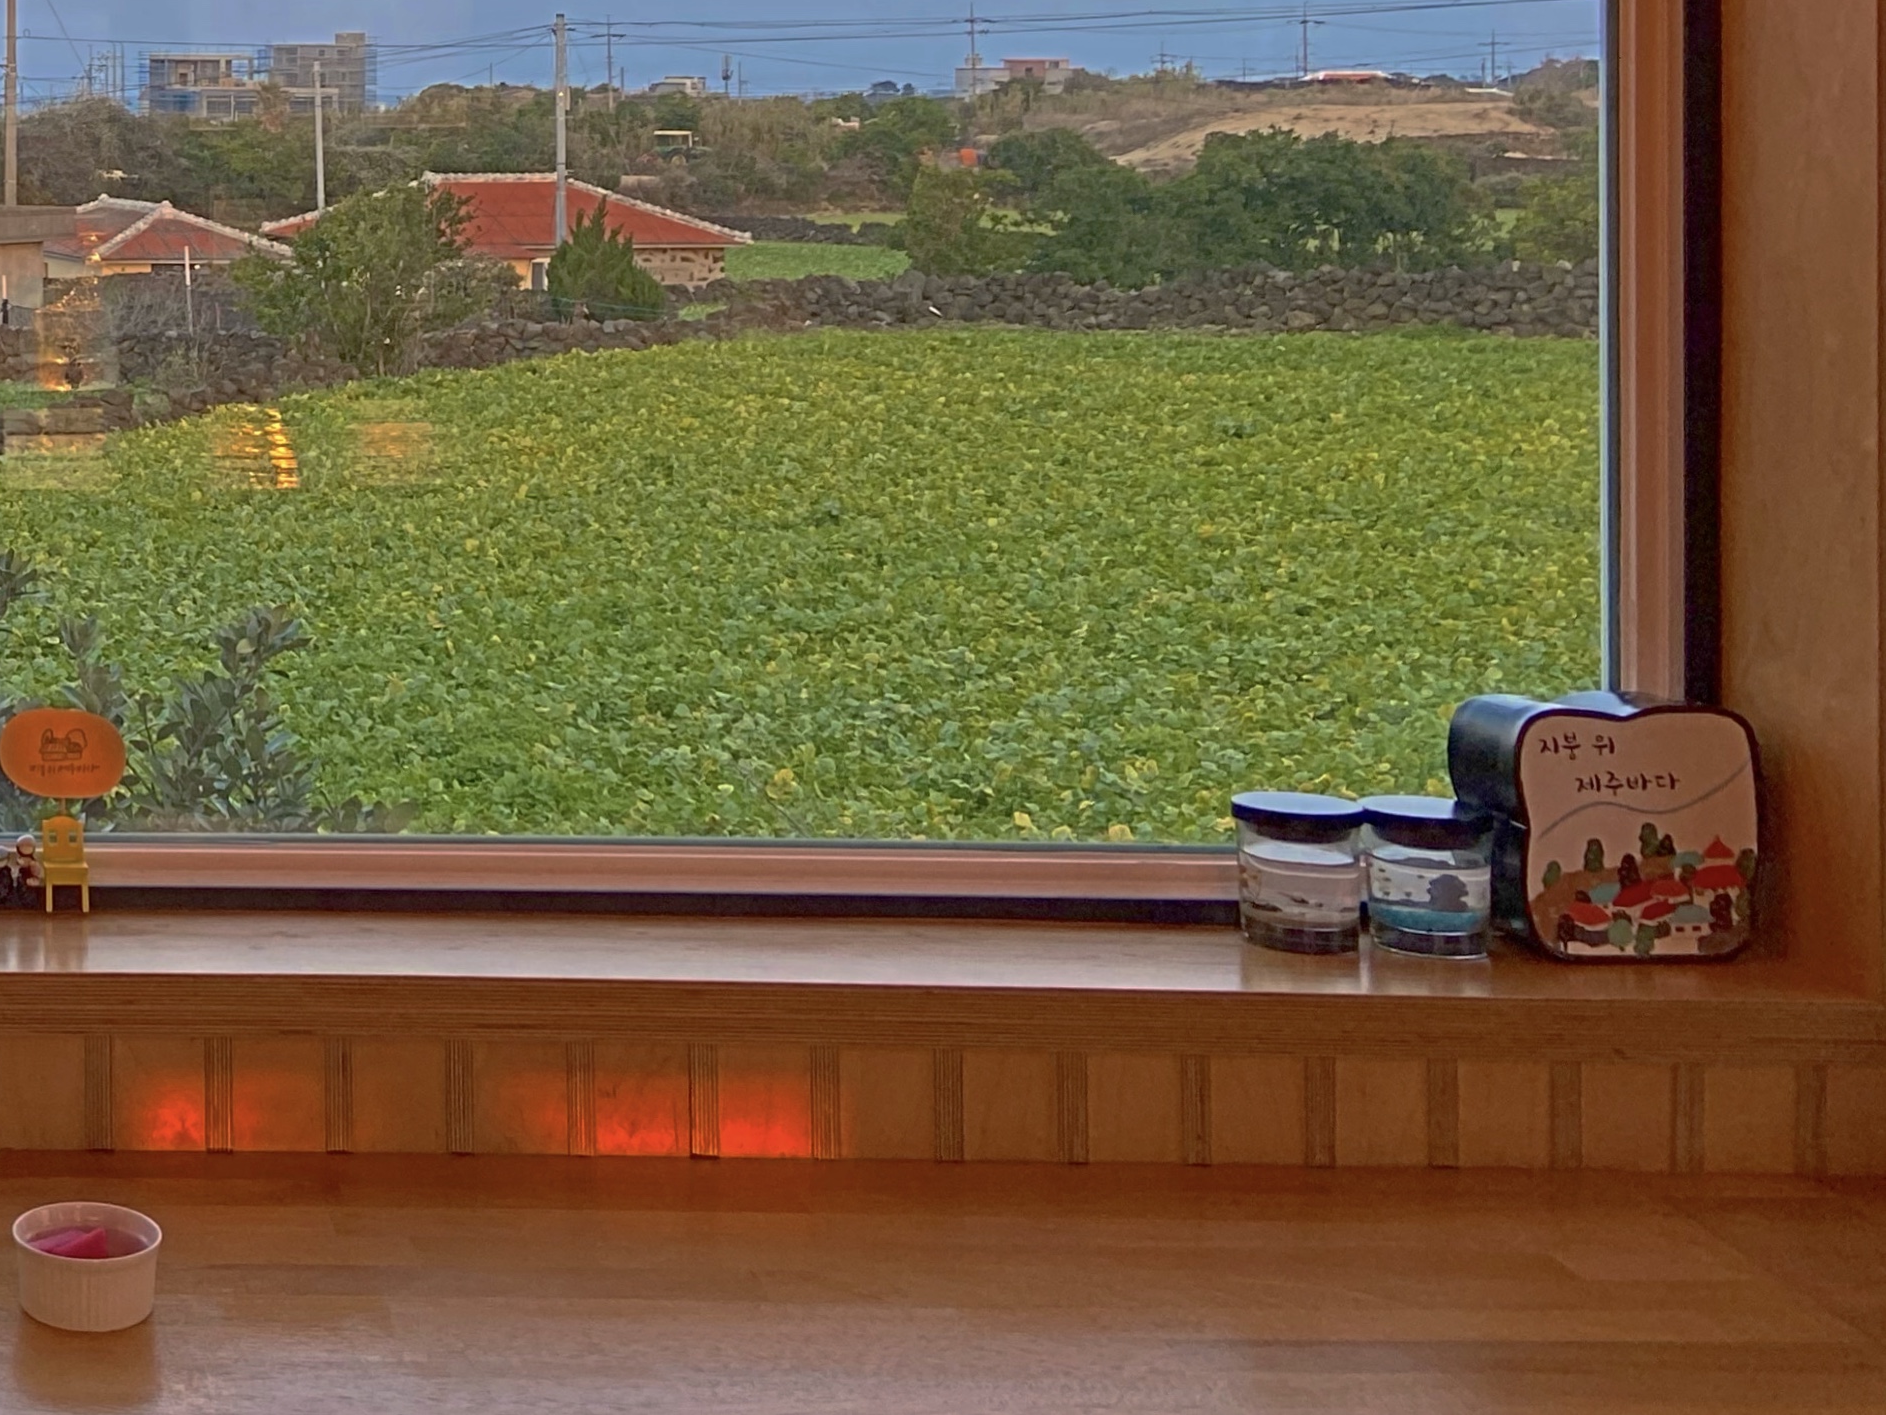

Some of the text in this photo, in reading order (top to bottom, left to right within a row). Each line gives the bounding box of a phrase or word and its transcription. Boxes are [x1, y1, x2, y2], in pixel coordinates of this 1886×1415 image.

[1539, 732, 1616, 761] 지붕 위
[1575, 770, 1680, 797] 제주바다
